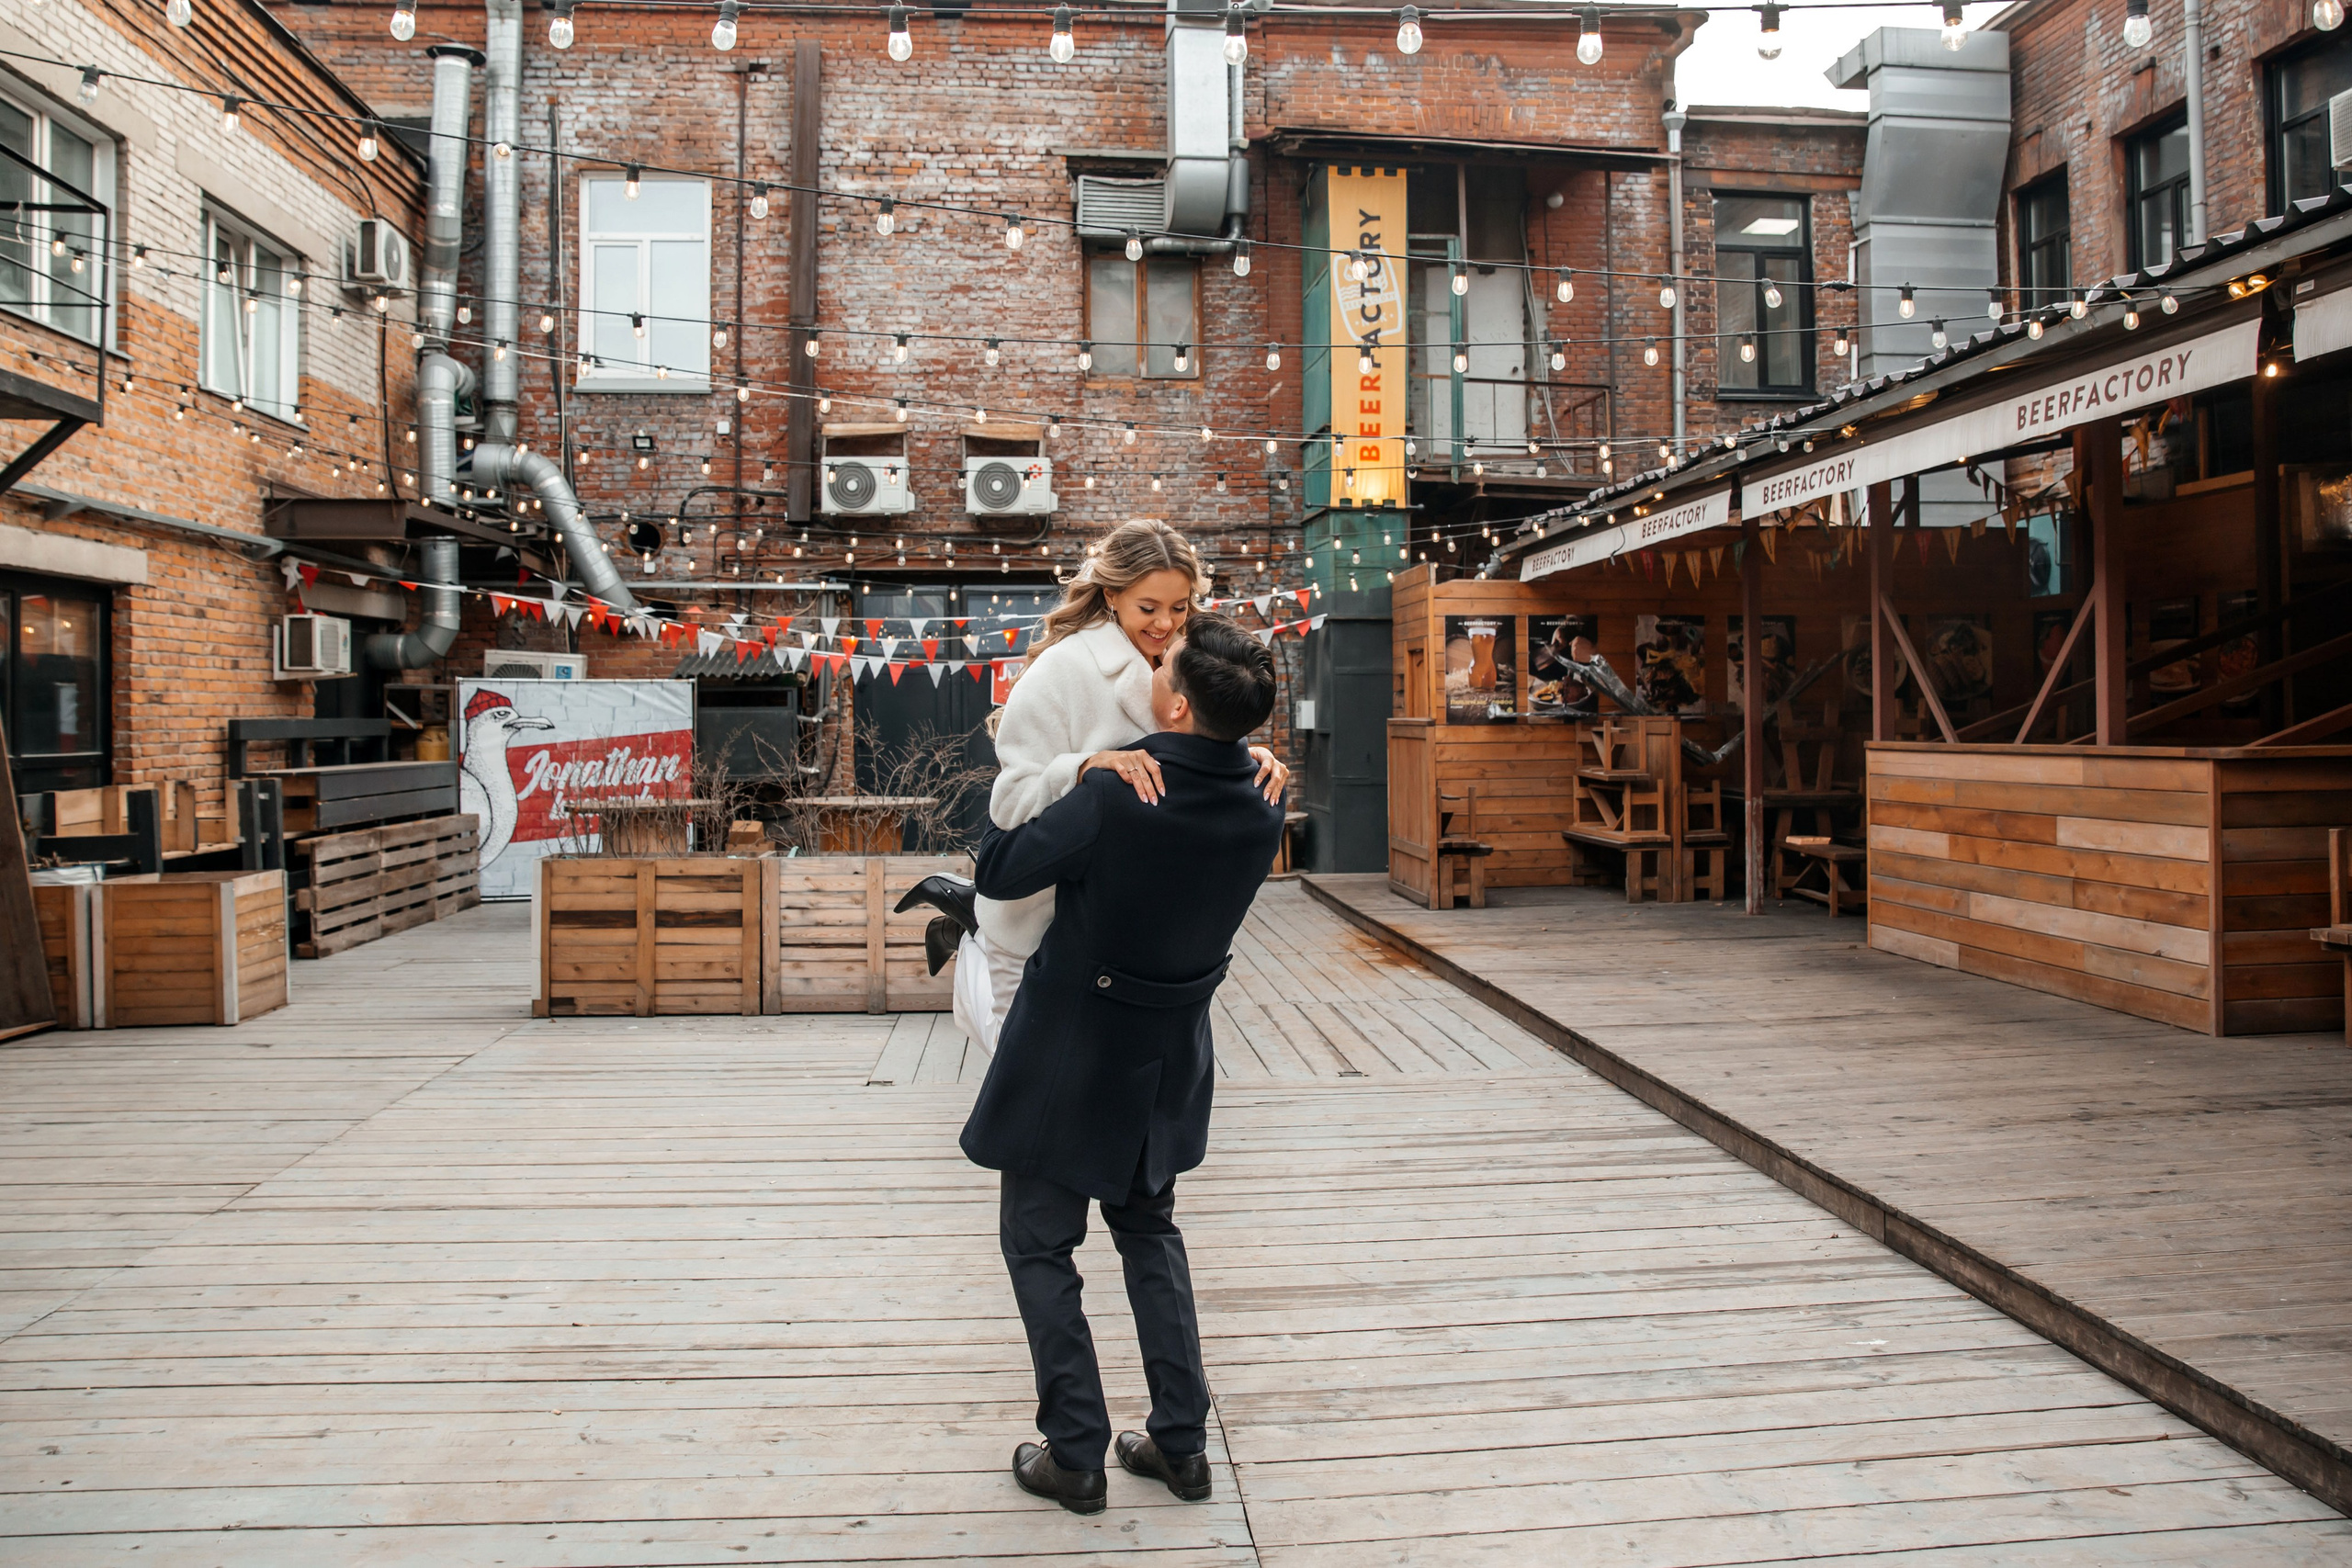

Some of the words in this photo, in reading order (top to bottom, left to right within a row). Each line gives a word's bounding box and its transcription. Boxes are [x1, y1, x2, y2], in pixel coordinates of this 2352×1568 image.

[2017, 350, 2193, 431] BEERFACTORY
[1763, 458, 1855, 505] BEERFACTORY
[1641, 503, 1708, 539] BEERFACTORY
[1532, 547, 1575, 572] BEERFACTORY
[516, 746, 682, 801] Jonathan
